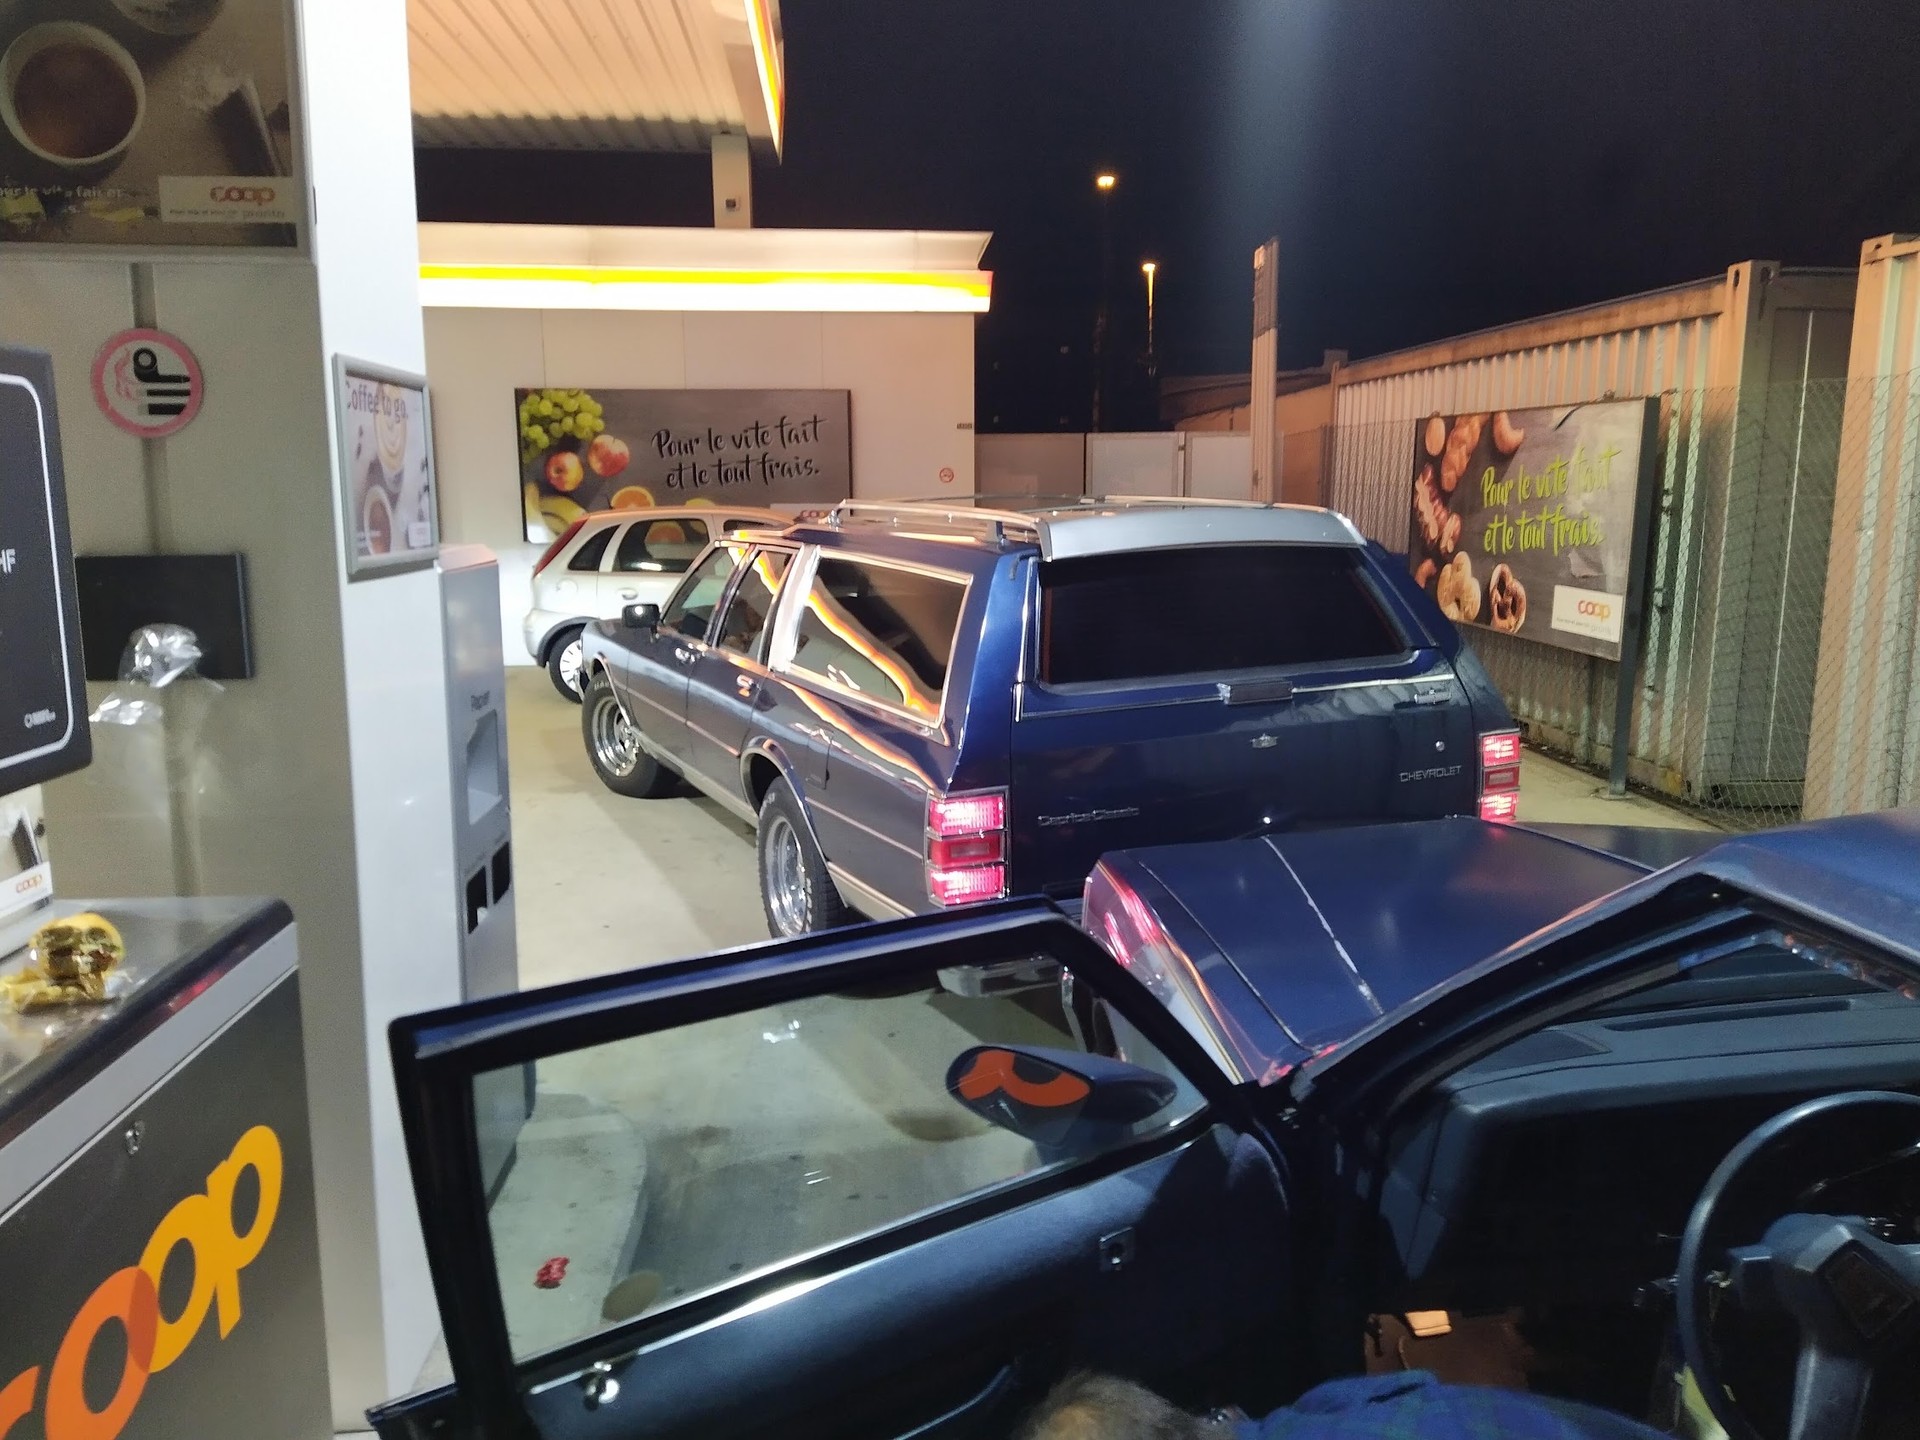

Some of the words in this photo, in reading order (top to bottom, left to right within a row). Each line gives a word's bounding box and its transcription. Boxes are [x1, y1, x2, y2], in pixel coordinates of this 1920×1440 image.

[209, 186, 275, 206] coop
[652, 428, 700, 458] Pour
[708, 427, 726, 453] le
[731, 420, 772, 449] vite
[774, 414, 828, 449] fait
[666, 462, 691, 489] et
[691, 462, 709, 488] le
[710, 453, 760, 487] tout
[756, 452, 820, 486] frais.
[1480, 466, 1514, 508] Pour
[1517, 464, 1532, 504] le
[1535, 454, 1570, 498] vite
[1484, 514, 1504, 555] et
[1502, 514, 1515, 555] le
[1515, 505, 1554, 553] tout
[1577, 600, 1611, 622] coop
[1399, 764, 1462, 782] CHEVROLET
[0, 1125, 284, 1440] oop
